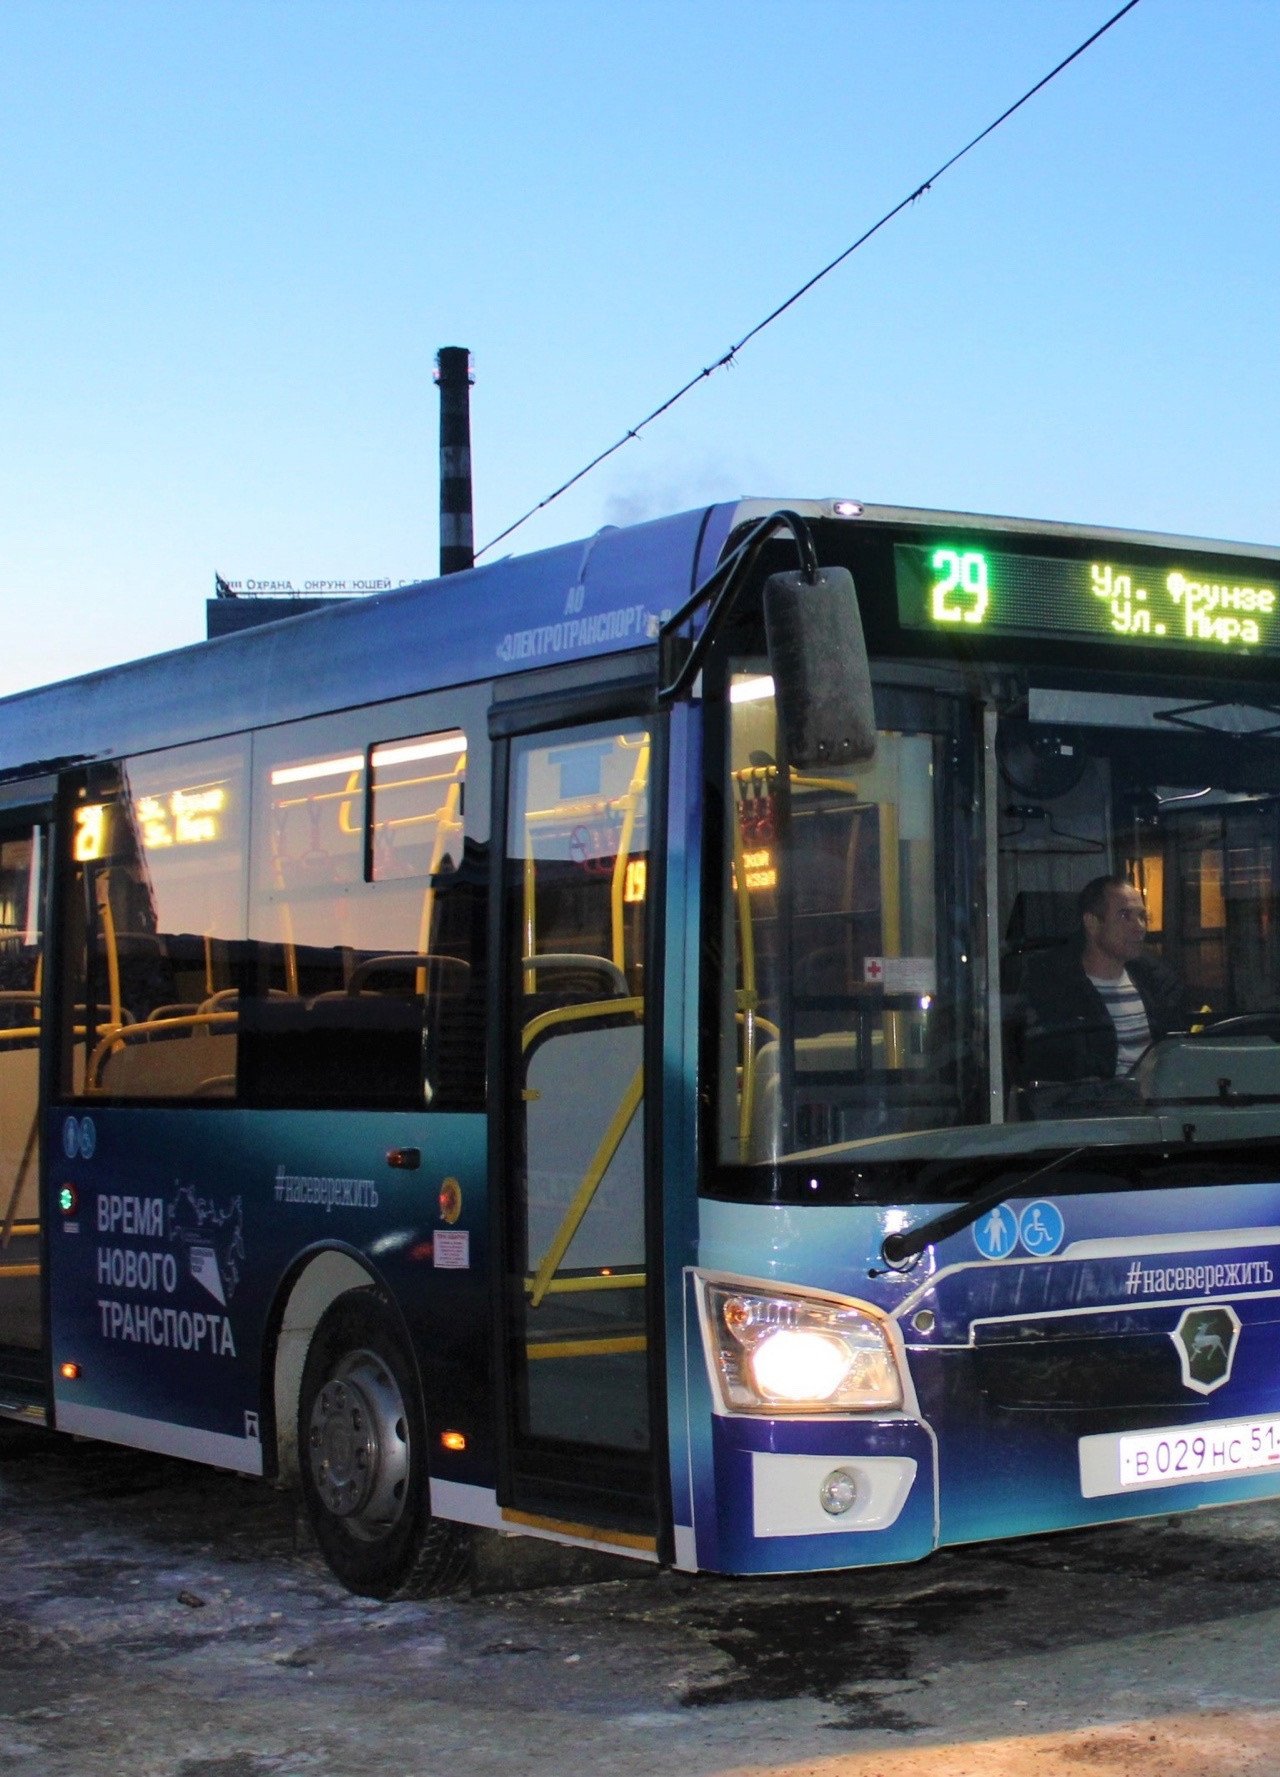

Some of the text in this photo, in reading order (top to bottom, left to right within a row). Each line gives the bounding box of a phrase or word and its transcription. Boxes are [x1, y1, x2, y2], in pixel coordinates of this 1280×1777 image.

[931, 549, 989, 624] 29
[1091, 563, 1276, 614] Ул. Фрунзе
[1110, 599, 1261, 644] Ул. Мира
[275, 1165, 379, 1212] #насевережить
[97, 1194, 163, 1237] ВРЕМЯ
[97, 1247, 177, 1293] НОВОГО
[1125, 1261, 1274, 1294] #насевережить
[98, 1300, 237, 1358] ТРАНСПОРТА
